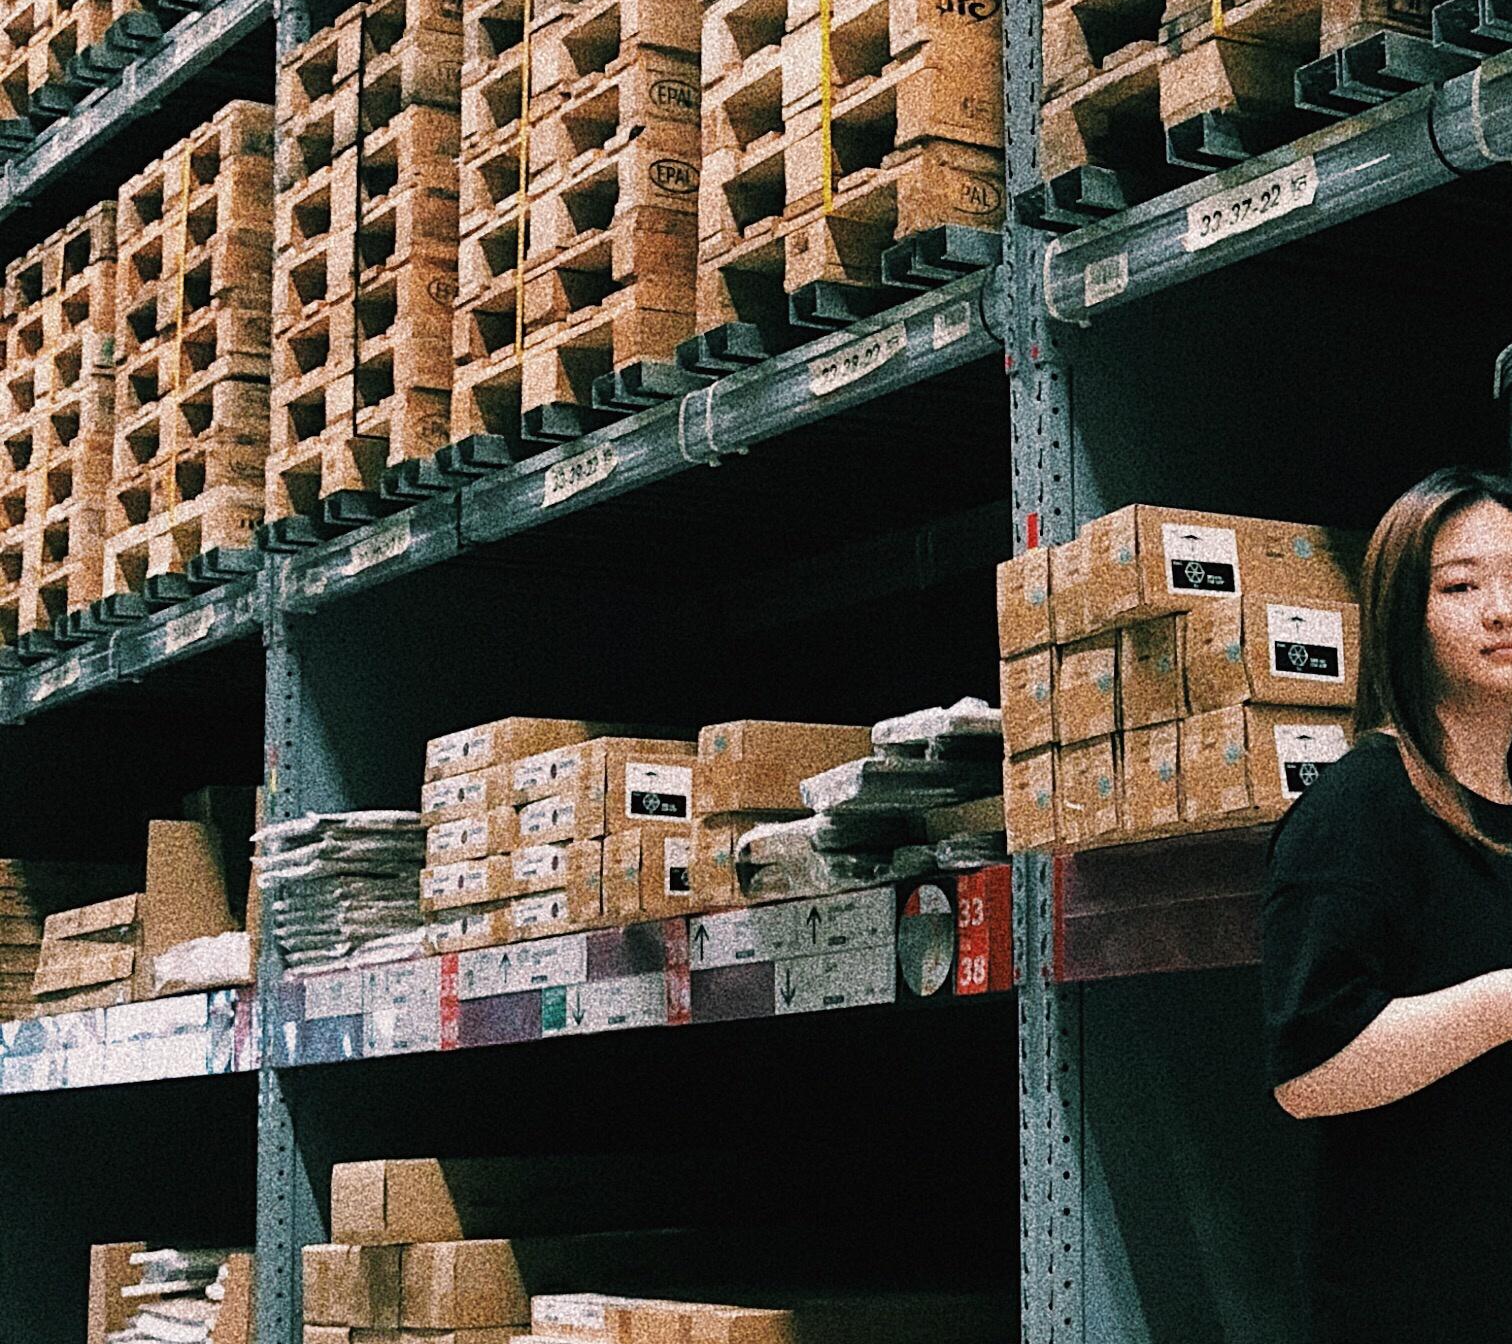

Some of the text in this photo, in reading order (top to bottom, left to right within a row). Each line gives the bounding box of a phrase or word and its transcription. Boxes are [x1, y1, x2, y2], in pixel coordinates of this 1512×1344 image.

[1199, 182, 1282, 237] 33-37-22
[958, 896, 985, 927] 33
[959, 955, 987, 987] 38
